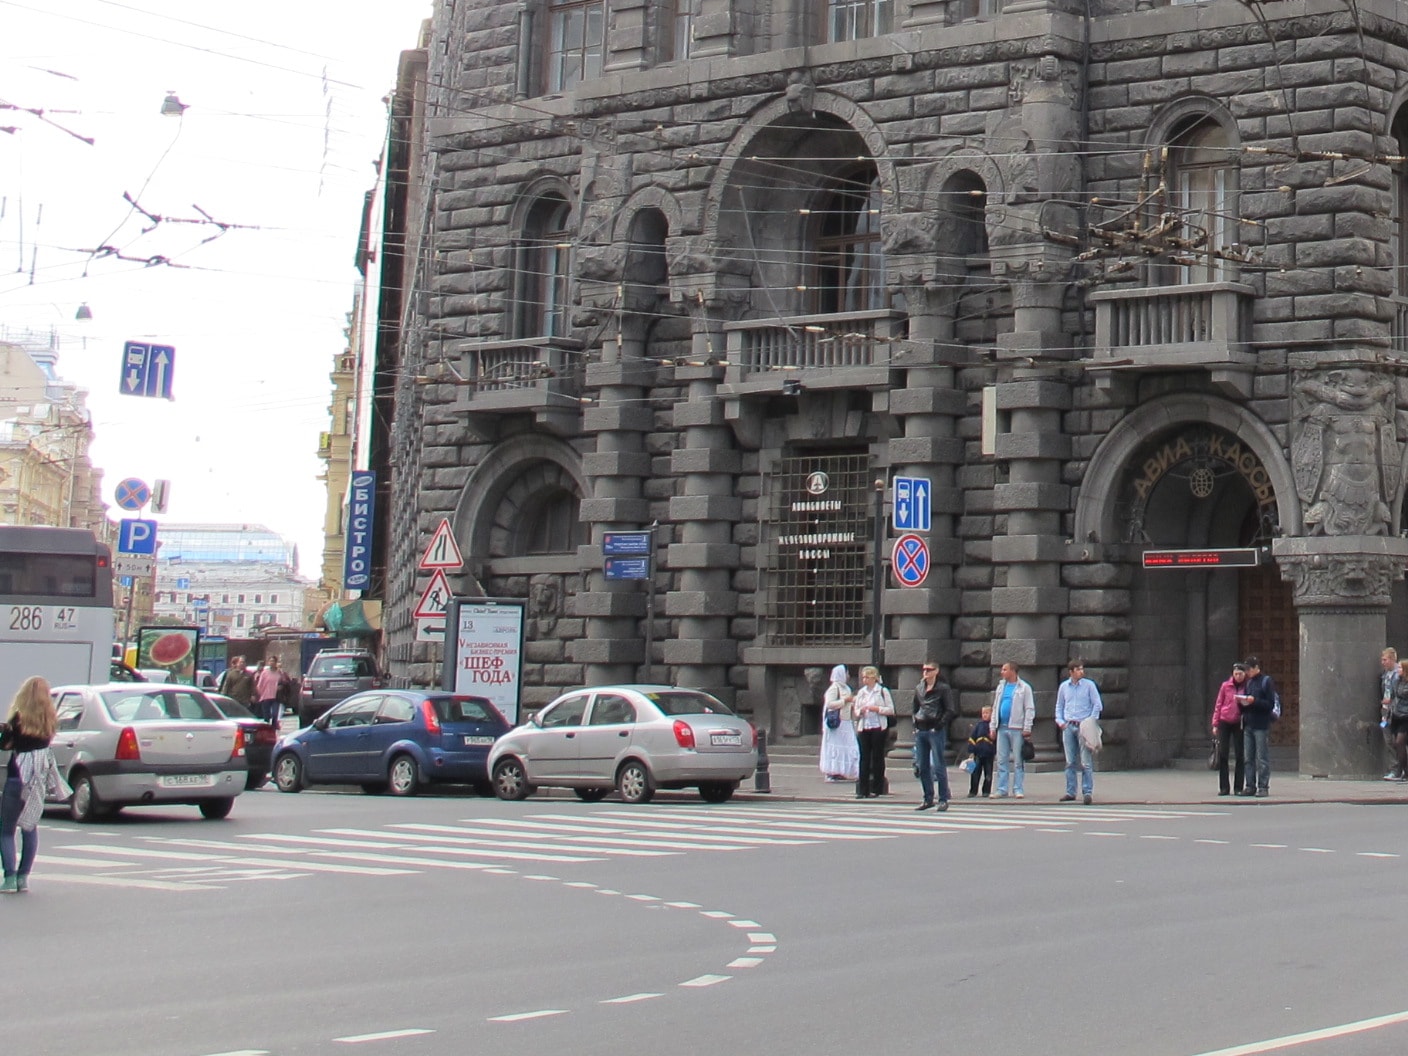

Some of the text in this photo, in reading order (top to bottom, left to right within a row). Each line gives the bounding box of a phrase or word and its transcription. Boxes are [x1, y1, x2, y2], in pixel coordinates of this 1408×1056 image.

[1134, 435, 1276, 506] АВИА КАССЫ
[351, 488, 369, 572] БИСТРО
[799, 549, 830, 560] КАССЫ
[9, 606, 43, 630] 286
[58, 608, 75, 622] 47
[463, 620, 474, 630] 13
